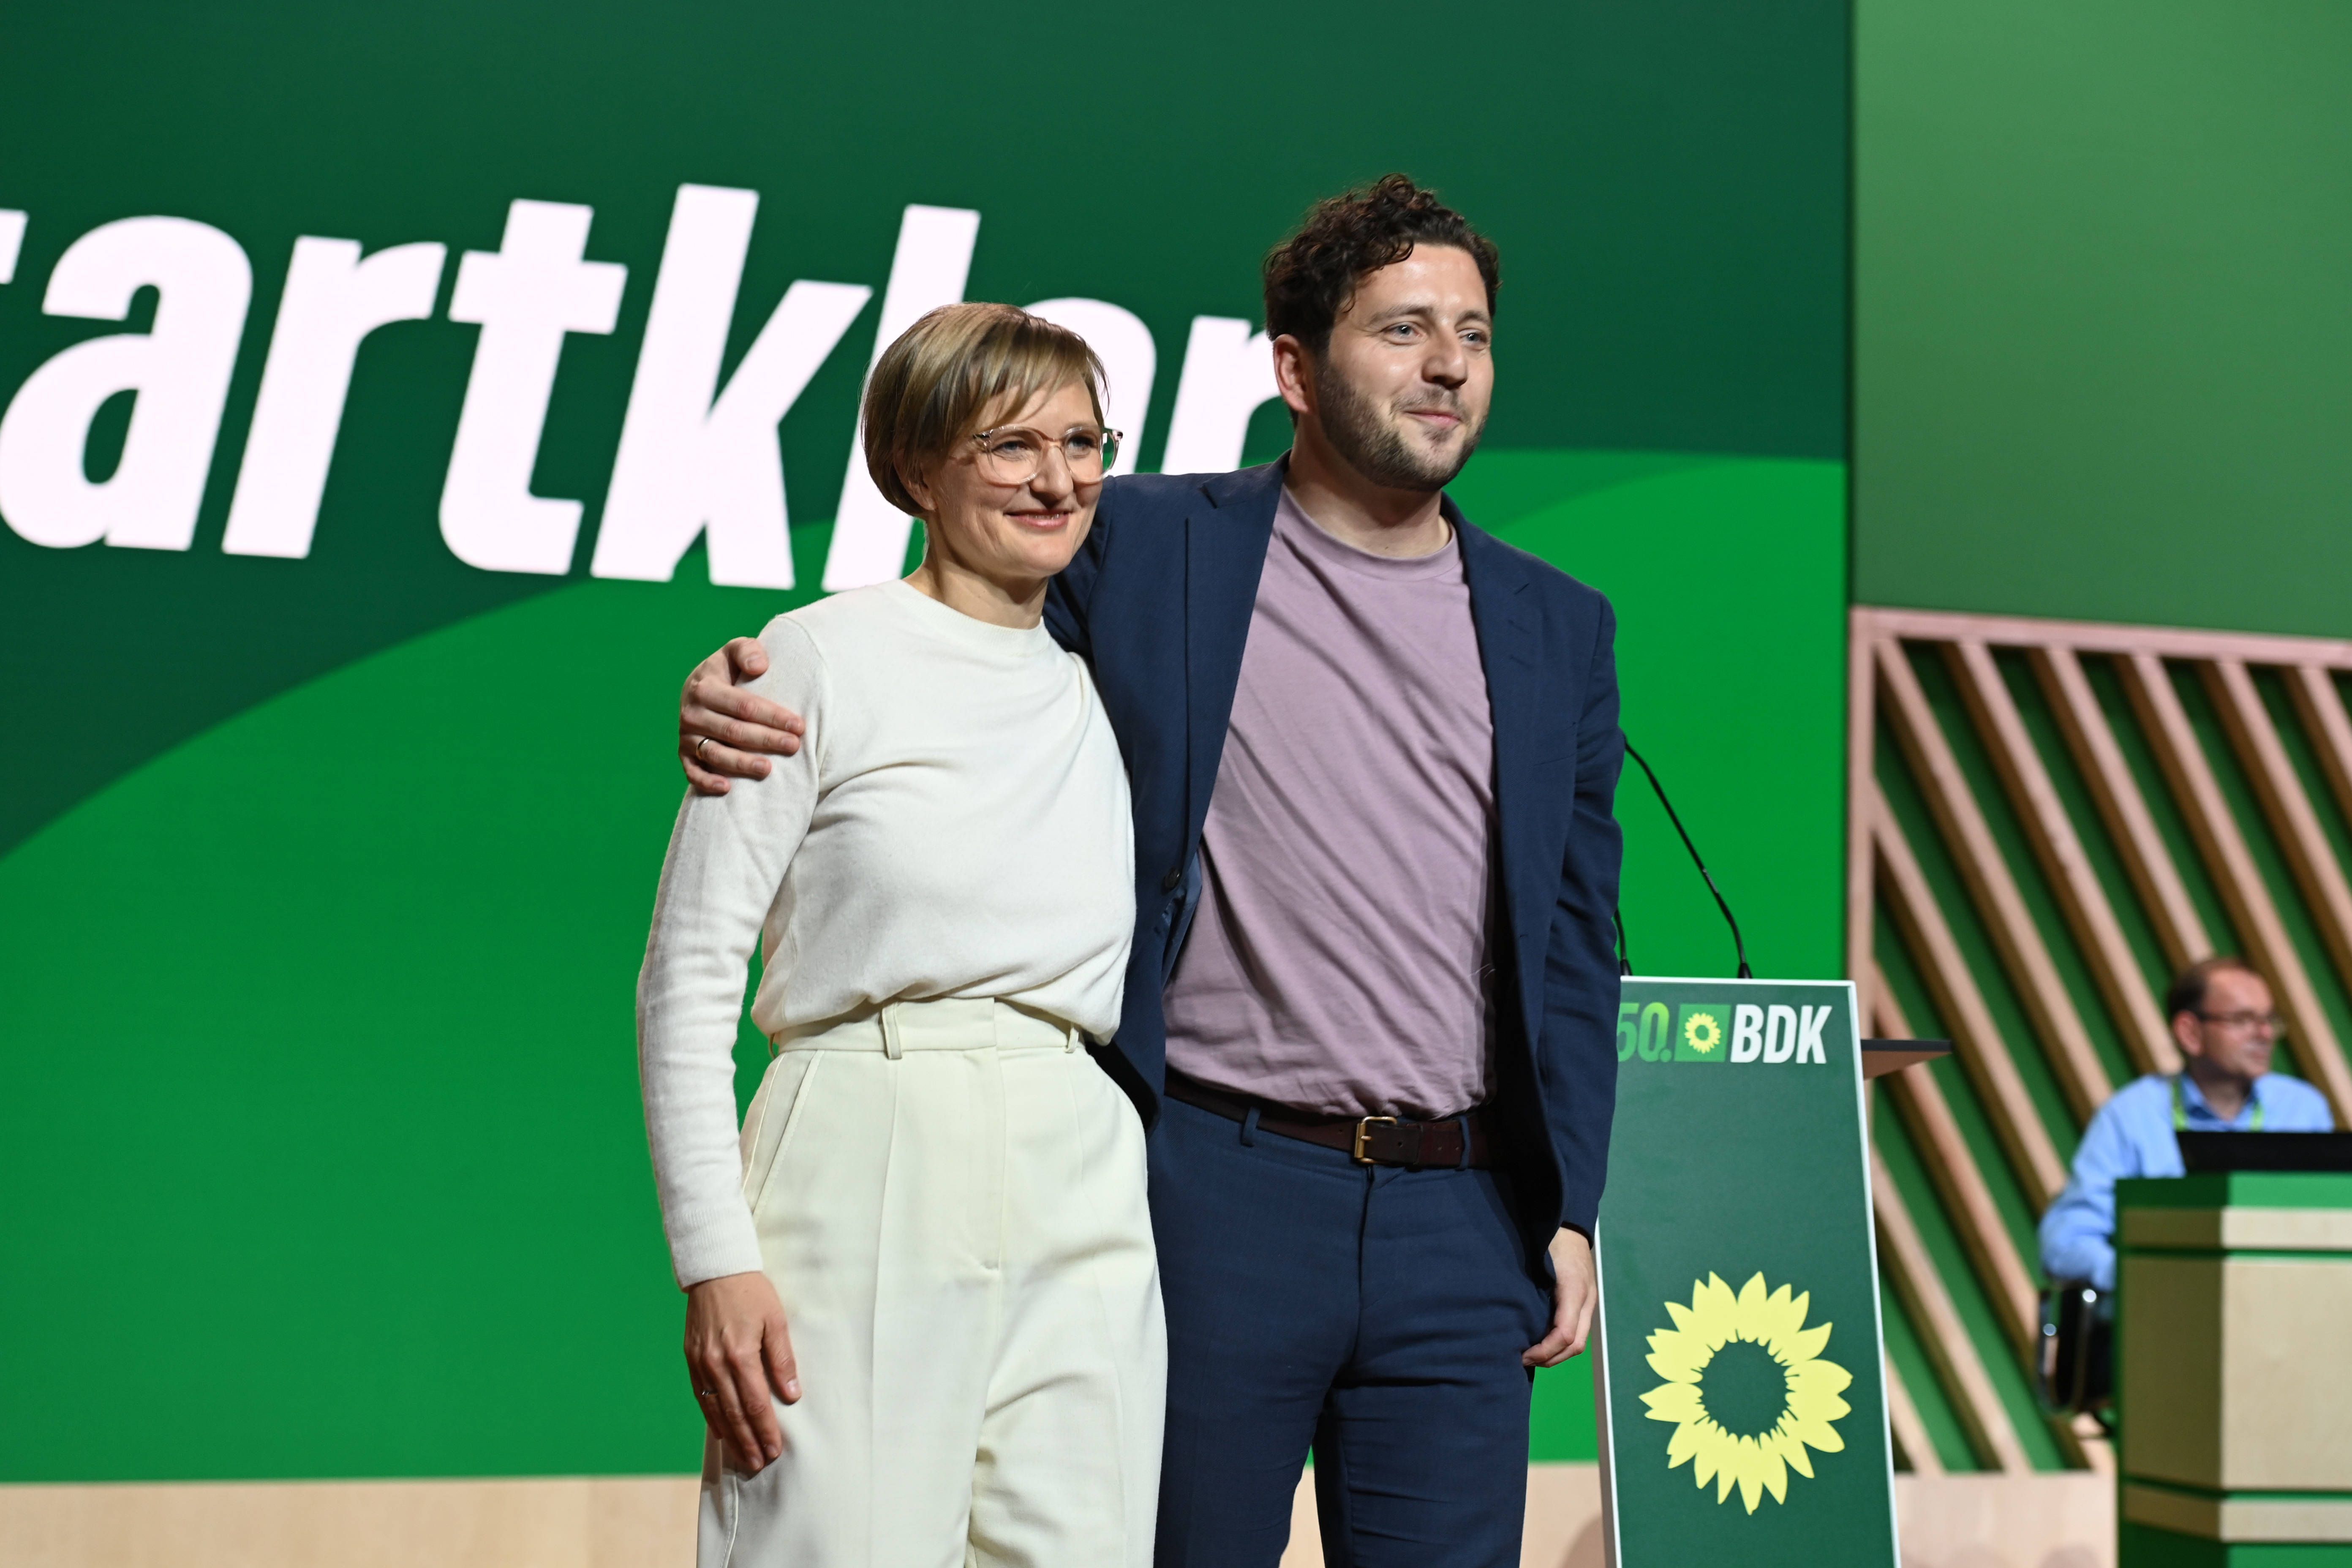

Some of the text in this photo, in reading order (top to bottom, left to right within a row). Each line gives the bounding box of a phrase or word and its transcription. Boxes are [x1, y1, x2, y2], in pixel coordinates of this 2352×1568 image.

[0, 183, 1282, 591] artklr
[1617, 1002, 1832, 1064] 50. BDK
